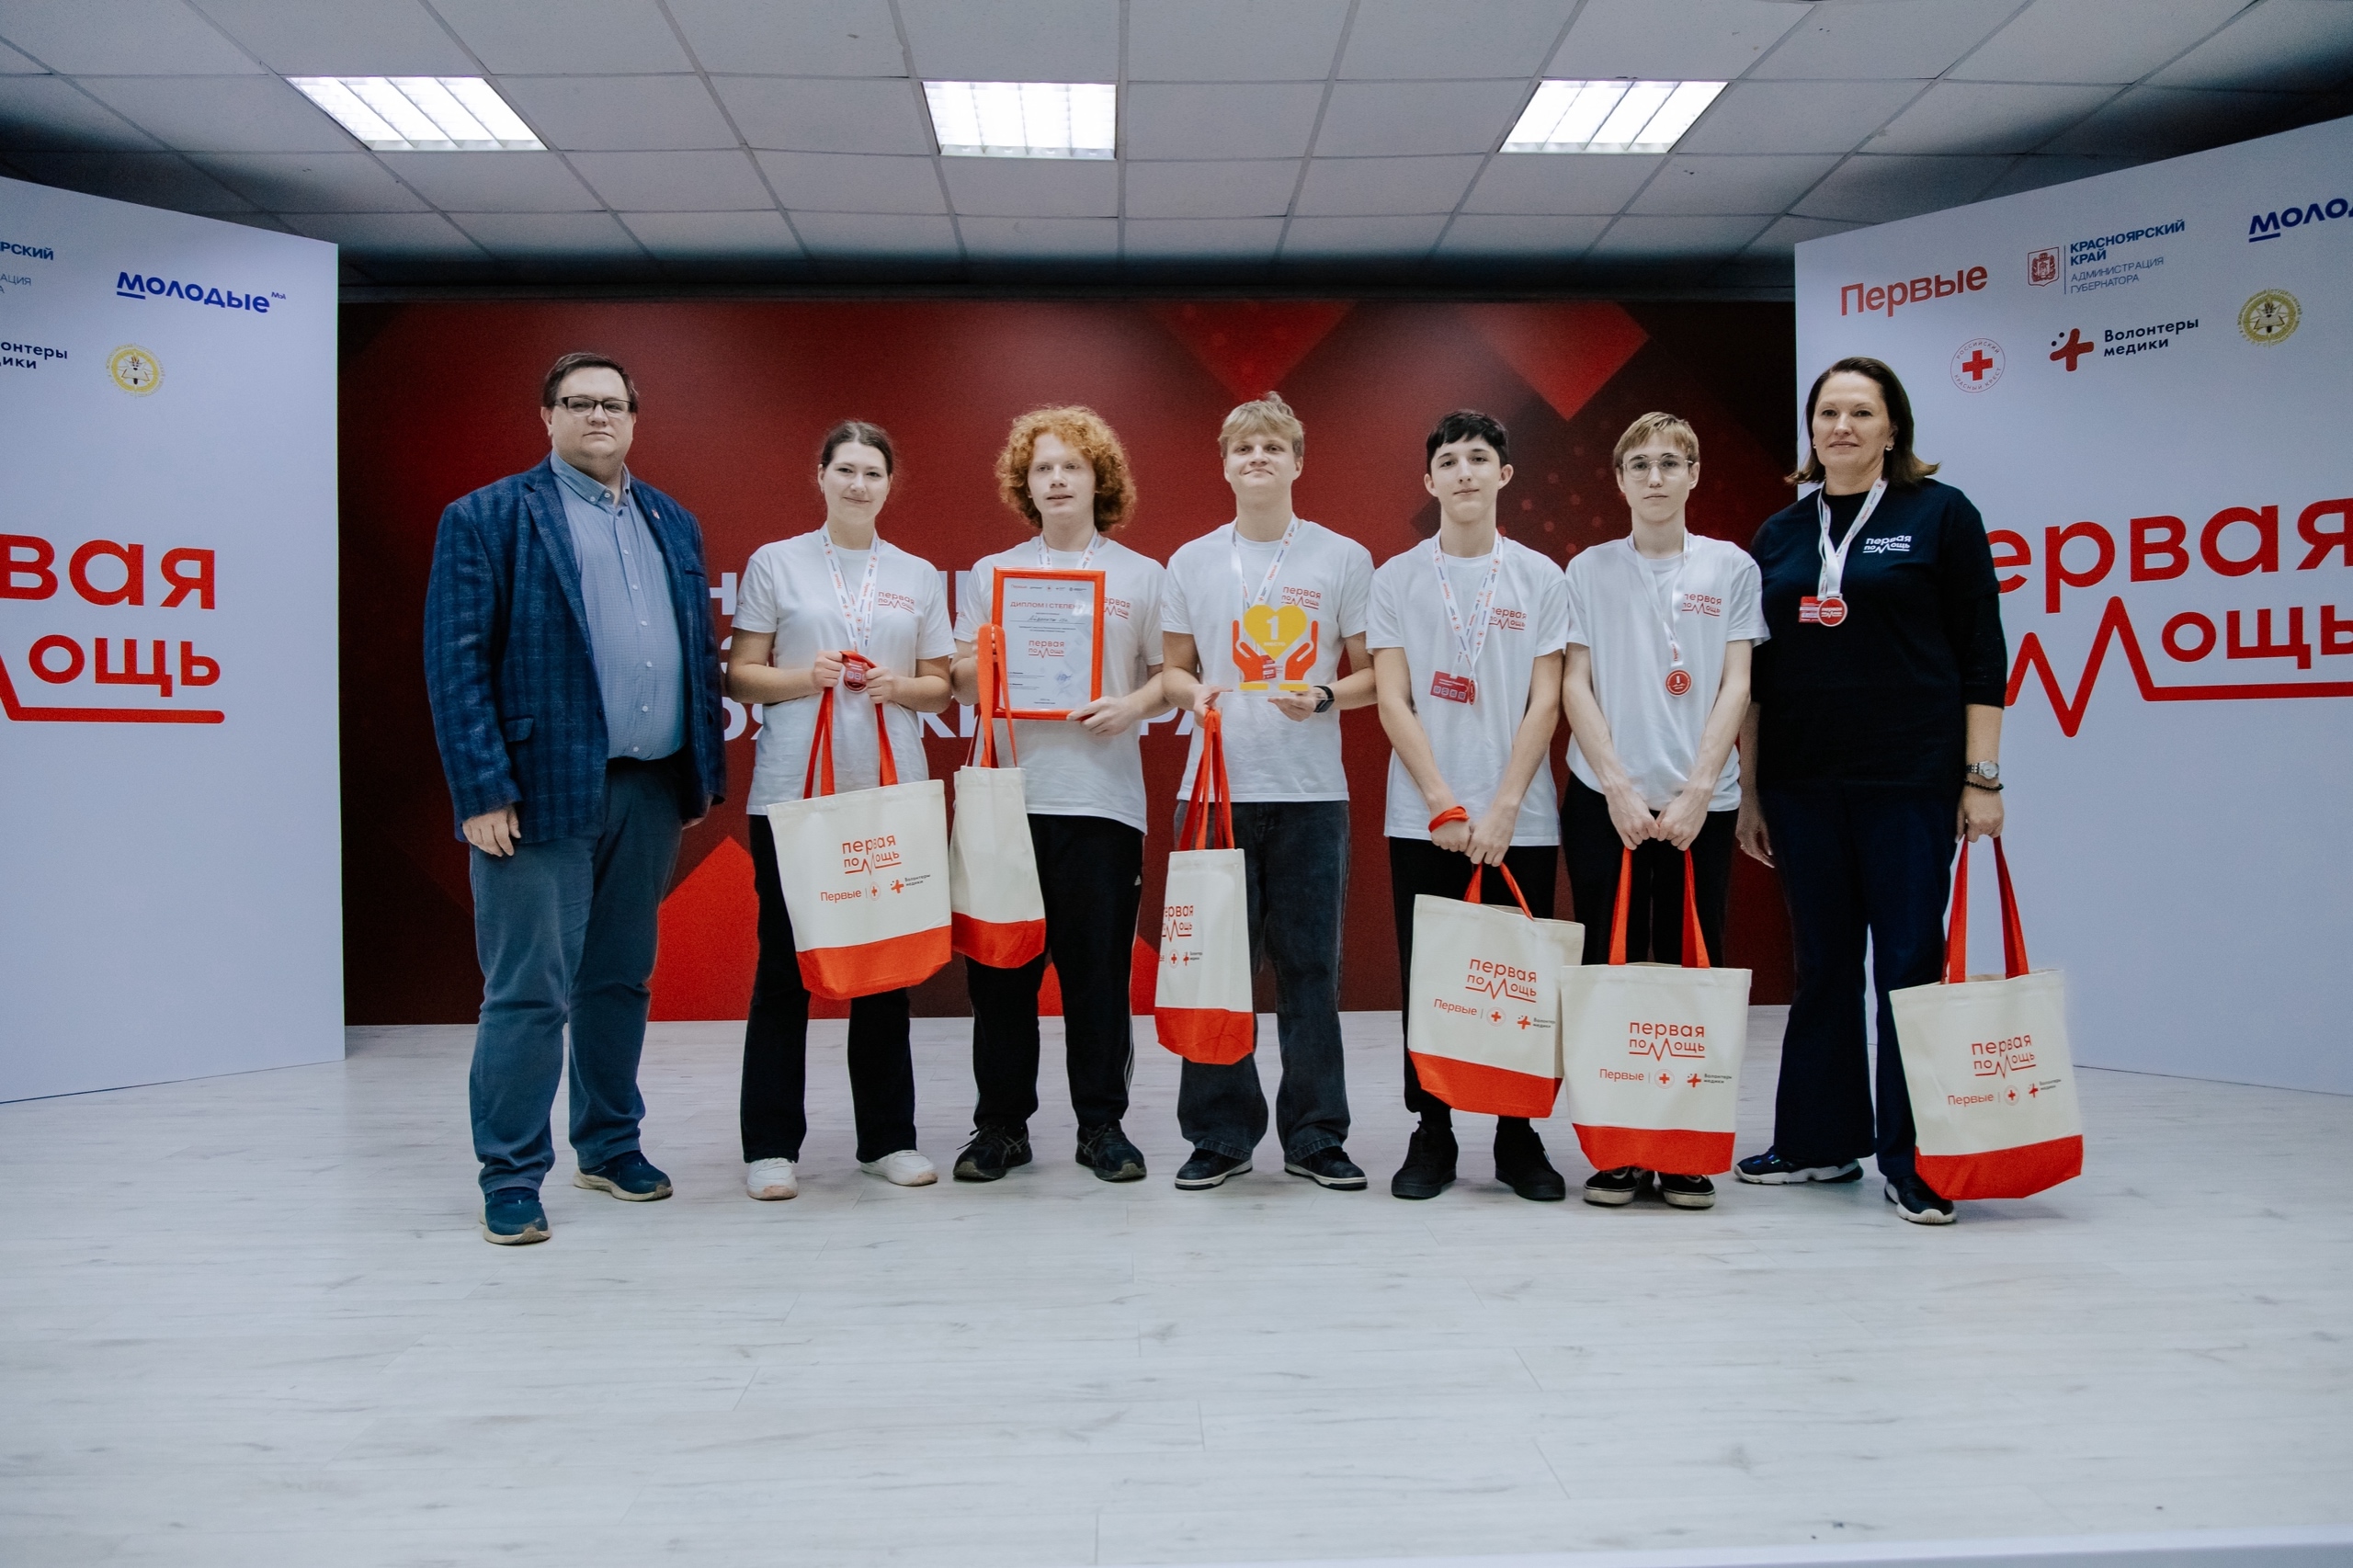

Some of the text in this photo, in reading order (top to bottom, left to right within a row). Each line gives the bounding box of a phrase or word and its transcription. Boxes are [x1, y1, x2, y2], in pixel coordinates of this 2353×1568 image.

[2070, 219, 2186, 254] КРАСНОЯРСКИЙ
[2070, 248, 2107, 267] КРАЙ
[2071, 256, 2165, 282] АДМИНИСТРАЦИЯ
[1840, 266, 1989, 318] Первые
[2071, 274, 2140, 294] ГУБЕРНАТОРА
[2104, 319, 2200, 343] Волонтеры
[2104, 338, 2169, 357] медики
[1866, 535, 1912, 546] первая
[1986, 497, 2353, 614] ервая
[878, 591, 915, 606] первая
[1282, 586, 1322, 599] первая
[1104, 597, 1131, 608] ервая
[1267, 615, 1279, 641] 1
[1029, 640, 1064, 648] первая
[2004, 596, 2353, 738] мощь
[842, 835, 896, 855] первая
[820, 890, 862, 903] Первые
[1469, 959, 1538, 983] первая
[1434, 998, 1478, 1016] Первые
[1629, 1022, 1705, 1040] первая
[1972, 1034, 2033, 1057] первая
[1599, 1068, 1644, 1083] Первые
[1948, 1093, 1995, 1108] Первые
